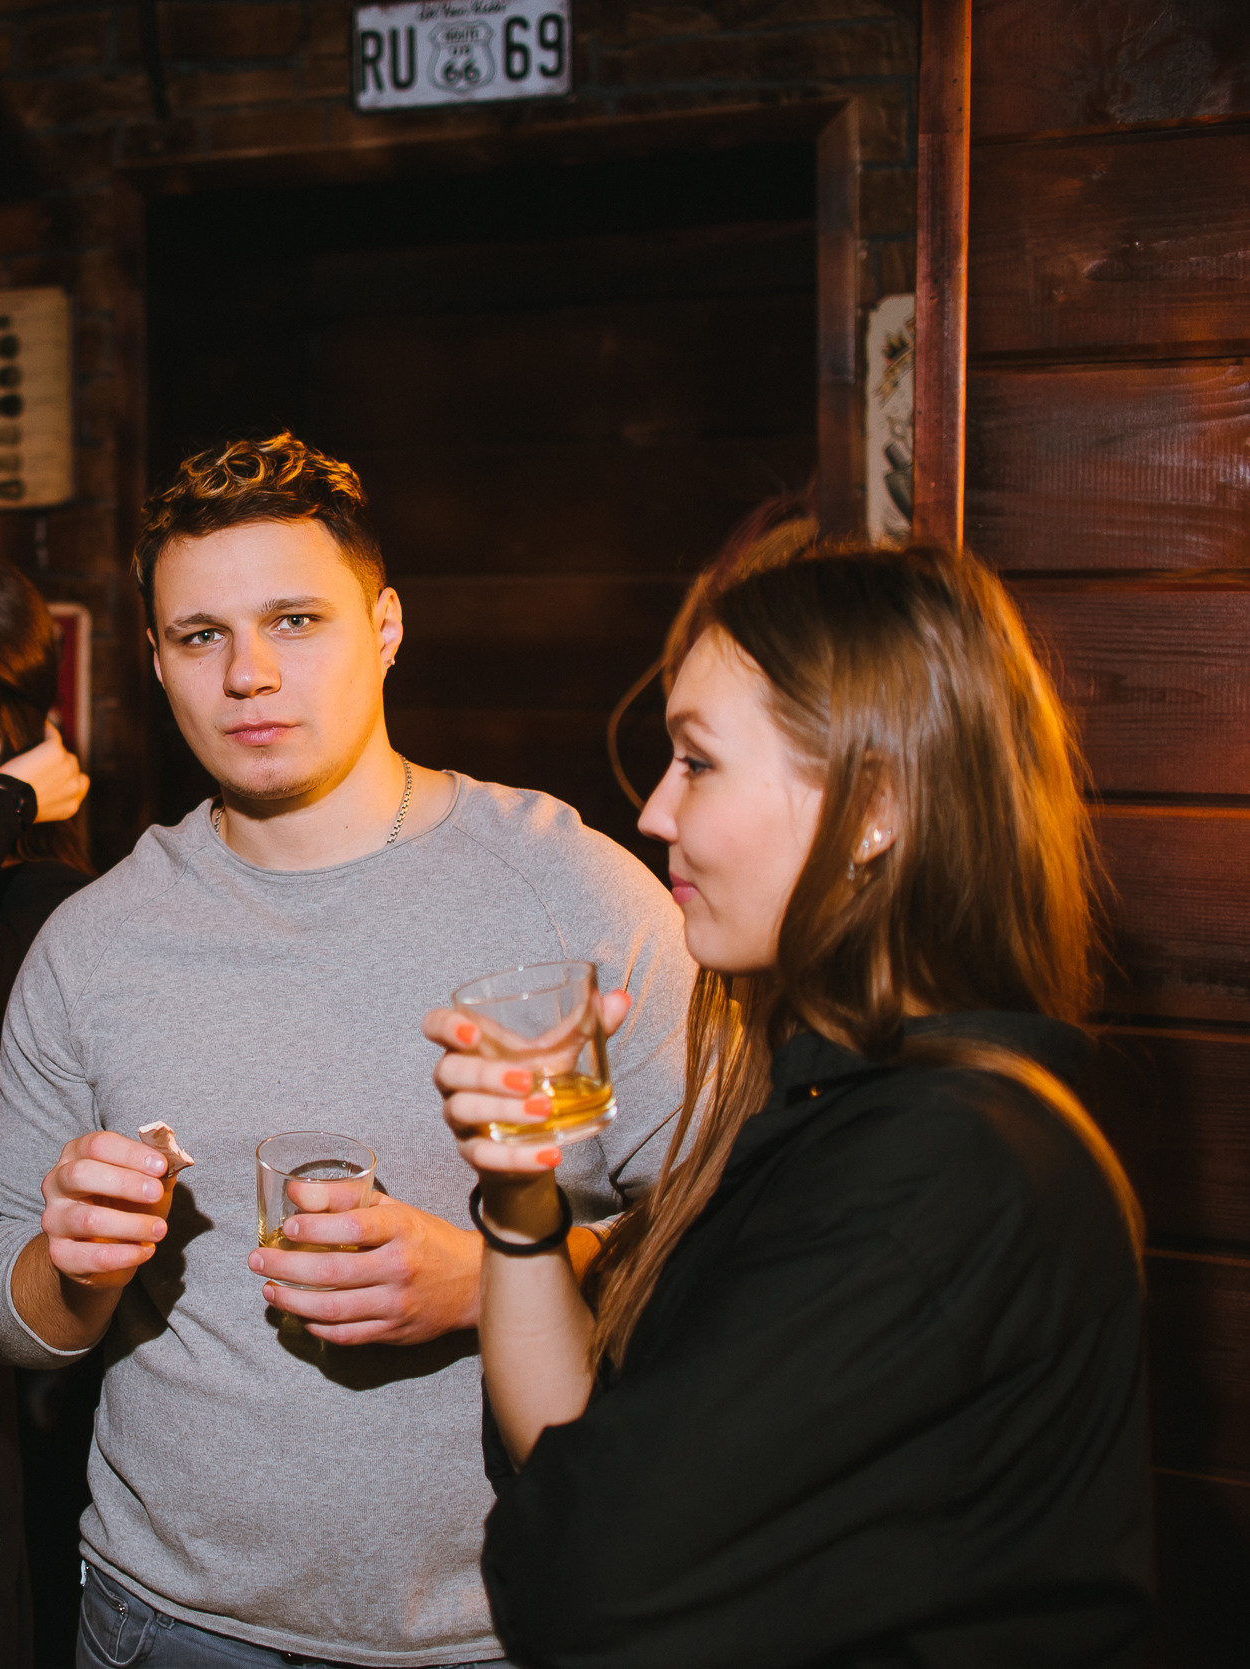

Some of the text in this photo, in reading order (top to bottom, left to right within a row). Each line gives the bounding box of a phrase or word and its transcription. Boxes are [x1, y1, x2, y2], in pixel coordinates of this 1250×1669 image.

[360, 14, 564, 92] RU 69
[444, 58, 481, 85] 66
